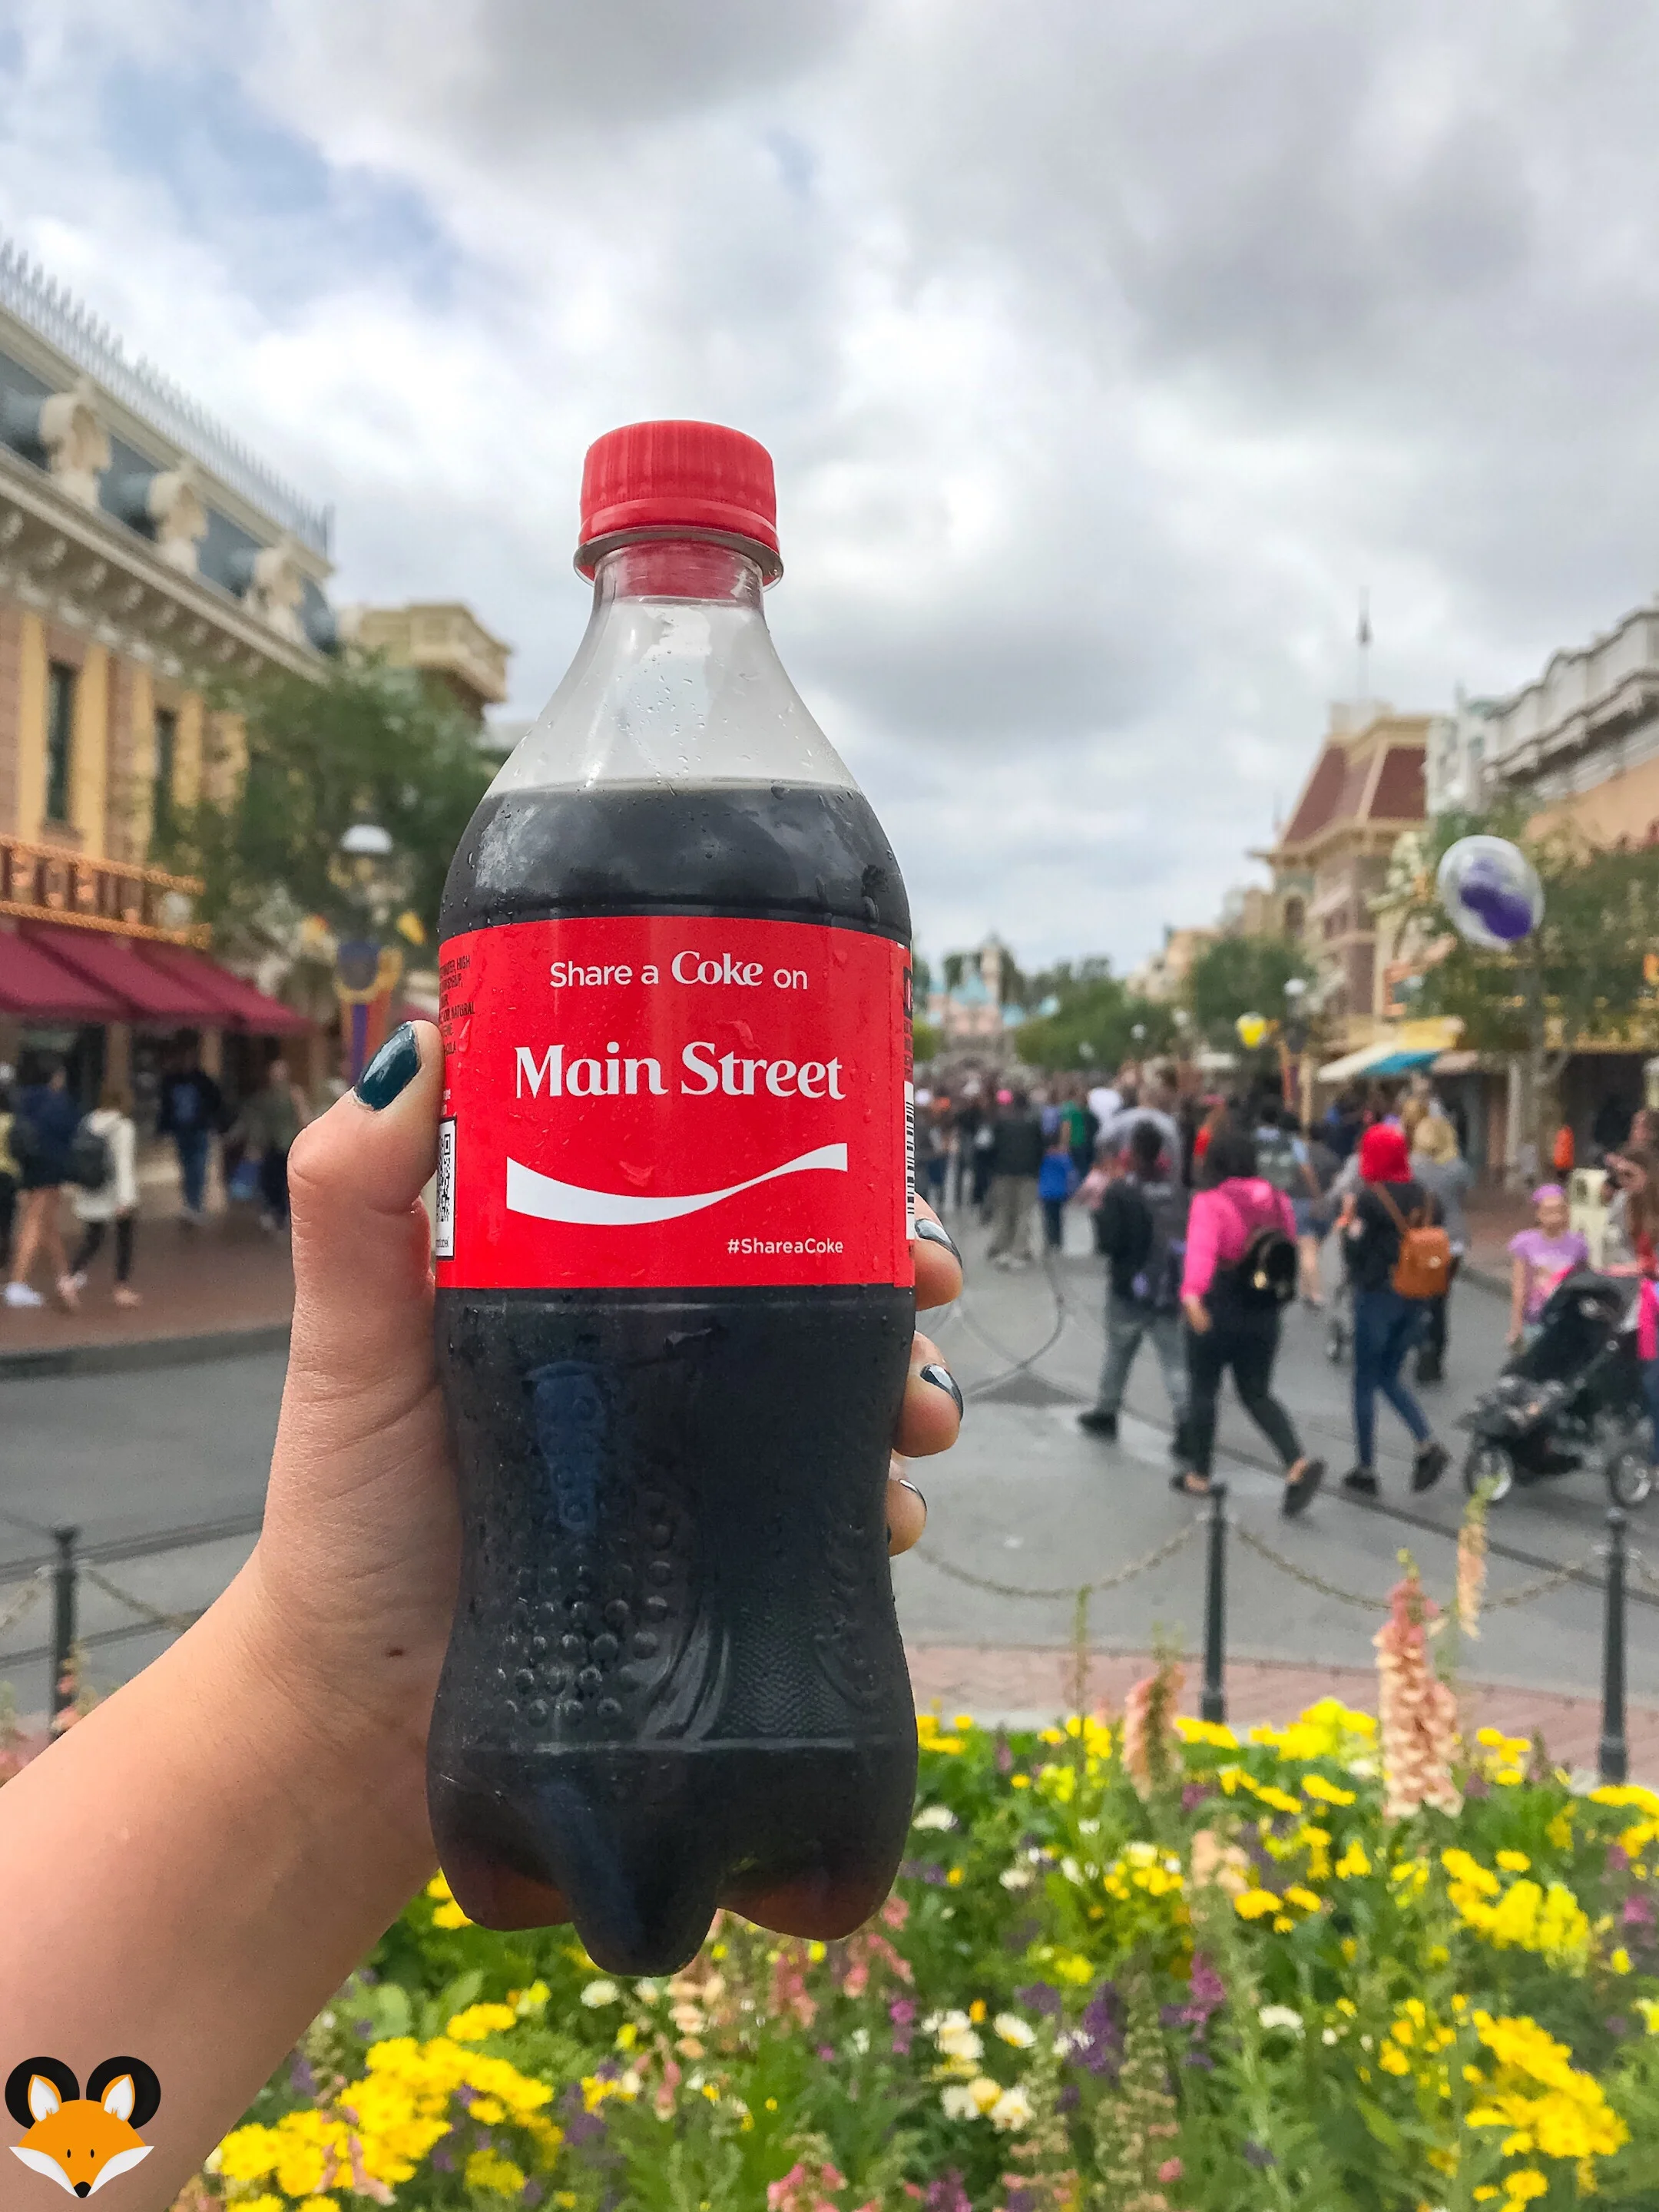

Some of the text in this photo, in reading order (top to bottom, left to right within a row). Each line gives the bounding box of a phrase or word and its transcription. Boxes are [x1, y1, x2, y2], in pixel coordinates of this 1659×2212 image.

[550, 950, 807, 990] Share a Coke on
[514, 1041, 669, 1099] Main
[680, 1041, 846, 1100] Street
[727, 1237, 843, 1254] #ShareaCoke
